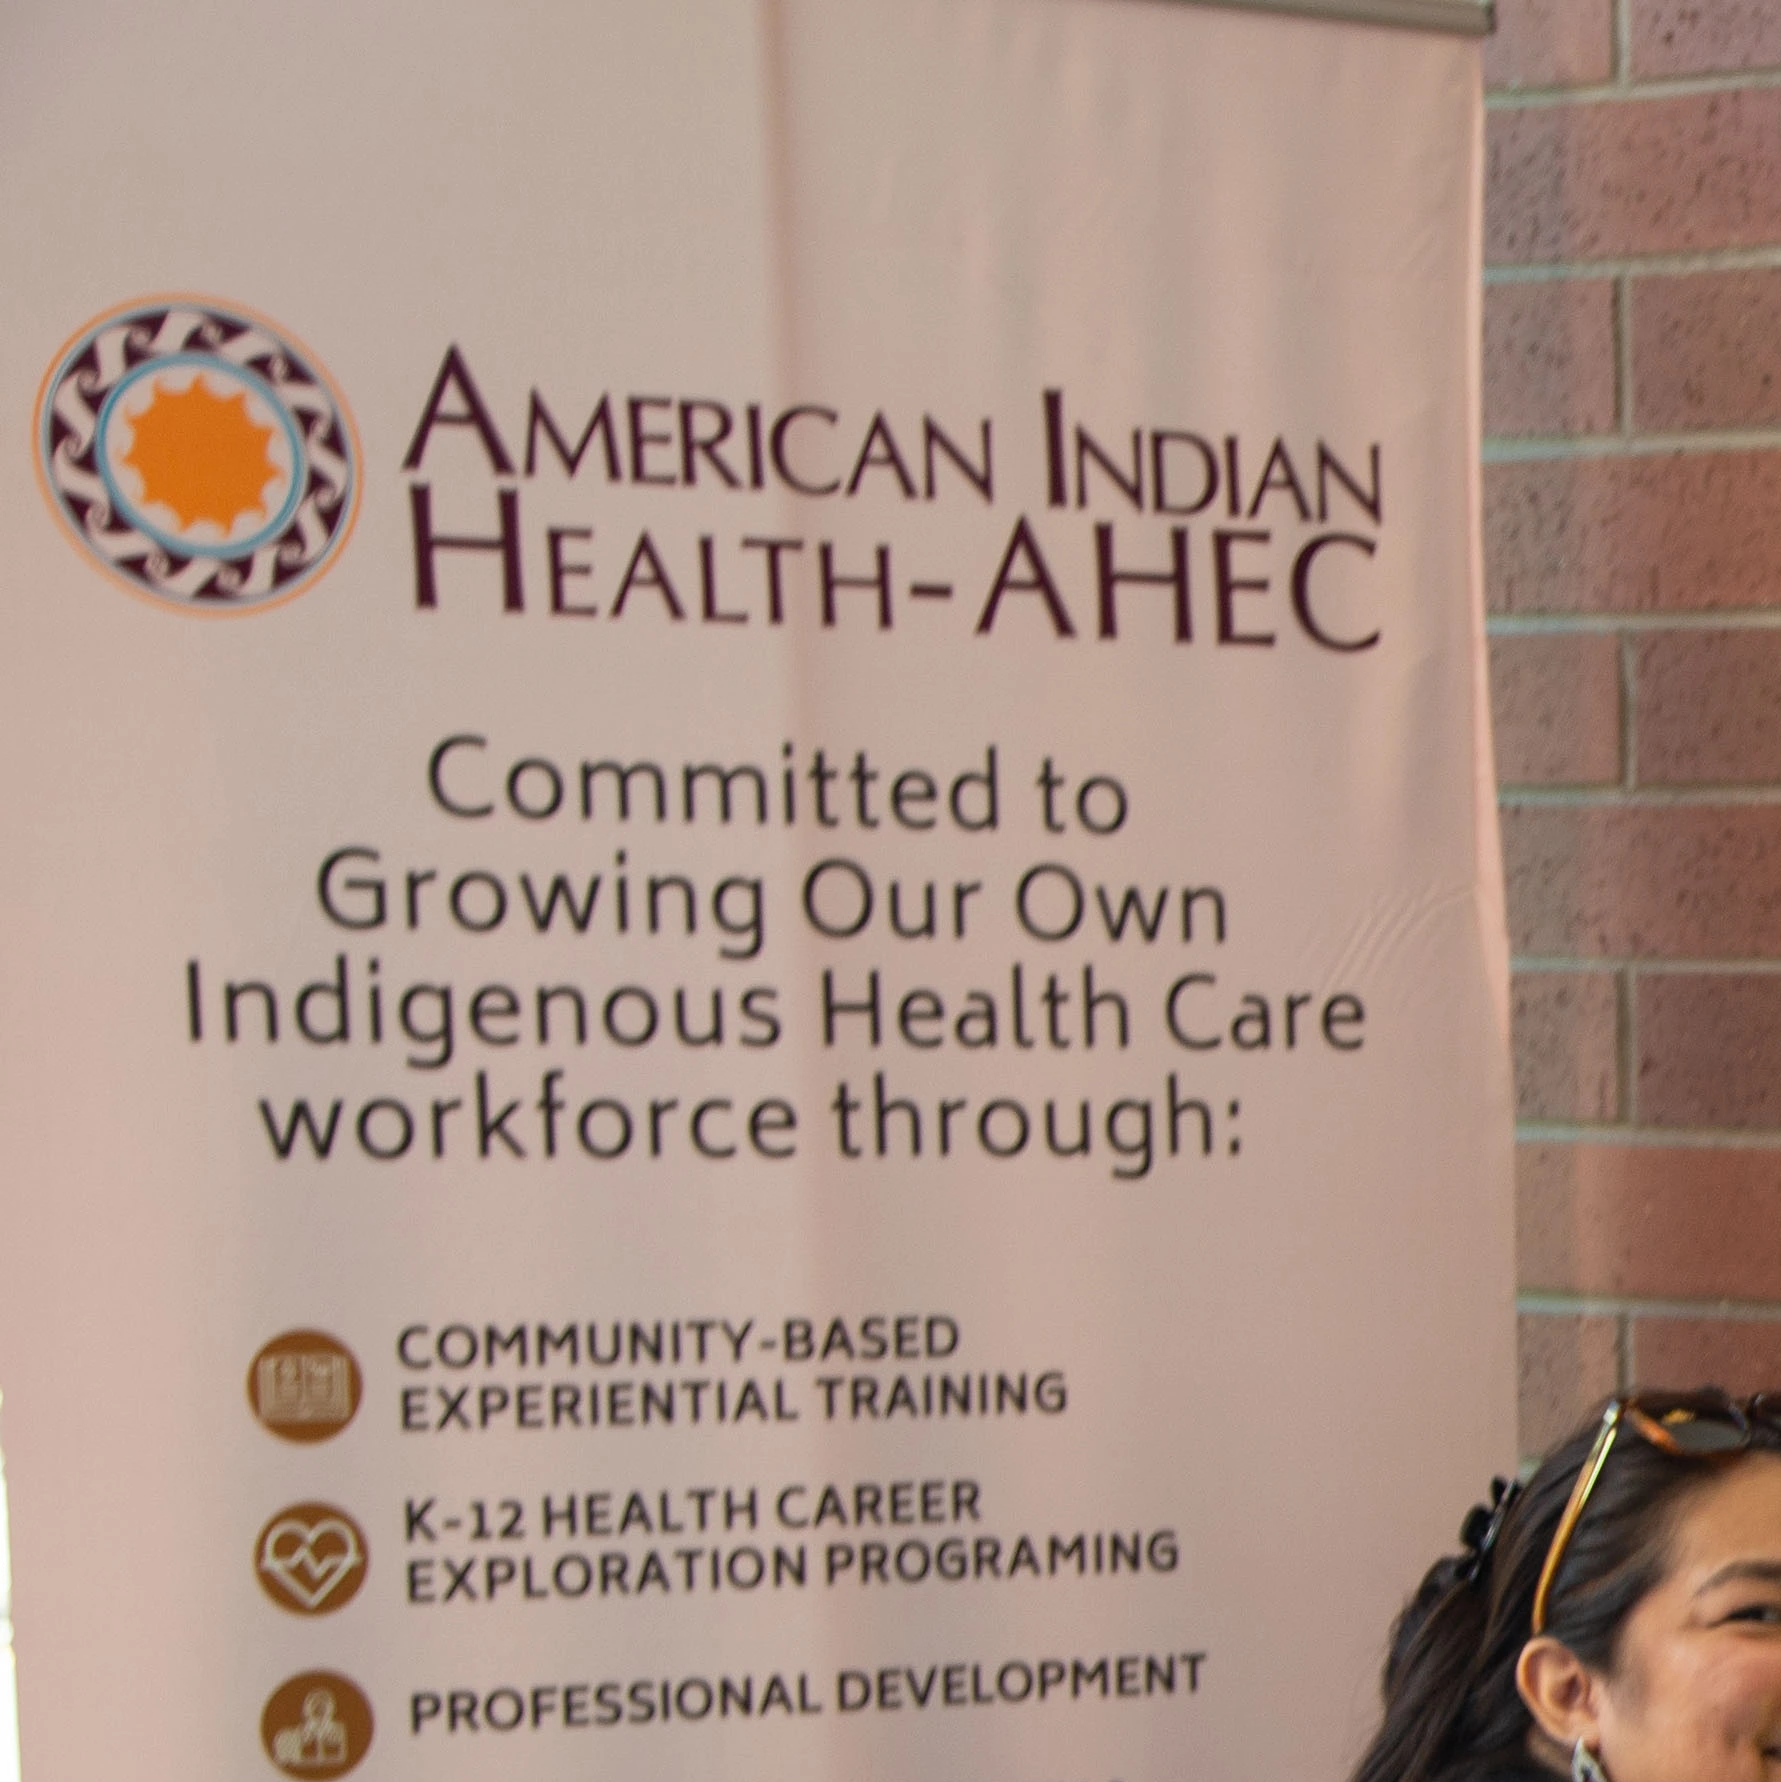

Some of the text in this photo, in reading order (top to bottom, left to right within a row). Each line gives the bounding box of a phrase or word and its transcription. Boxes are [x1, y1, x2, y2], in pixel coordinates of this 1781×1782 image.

[403, 345, 1381, 524] AMERICAN INDIAN
[410, 482, 1381, 653] HEALTH-AHEC
[428, 735, 1128, 835] Committed to
[317, 847, 1226, 960] Growing Our Own
[187, 954, 1365, 1069] Indigenous Health Care
[259, 1069, 1240, 1180] workforce through:
[397, 1316, 959, 1370] COMMUNITY-BASED
[401, 1372, 1067, 1432] EXPERIENTIAL TRAINING
[404, 1480, 980, 1543] K-12 HEALTH CAREER
[406, 1531, 1178, 1602] EXPLORATION PROGRAMING
[411, 1653, 1206, 1735] PROFESSIONAL DEVELOPMENT
